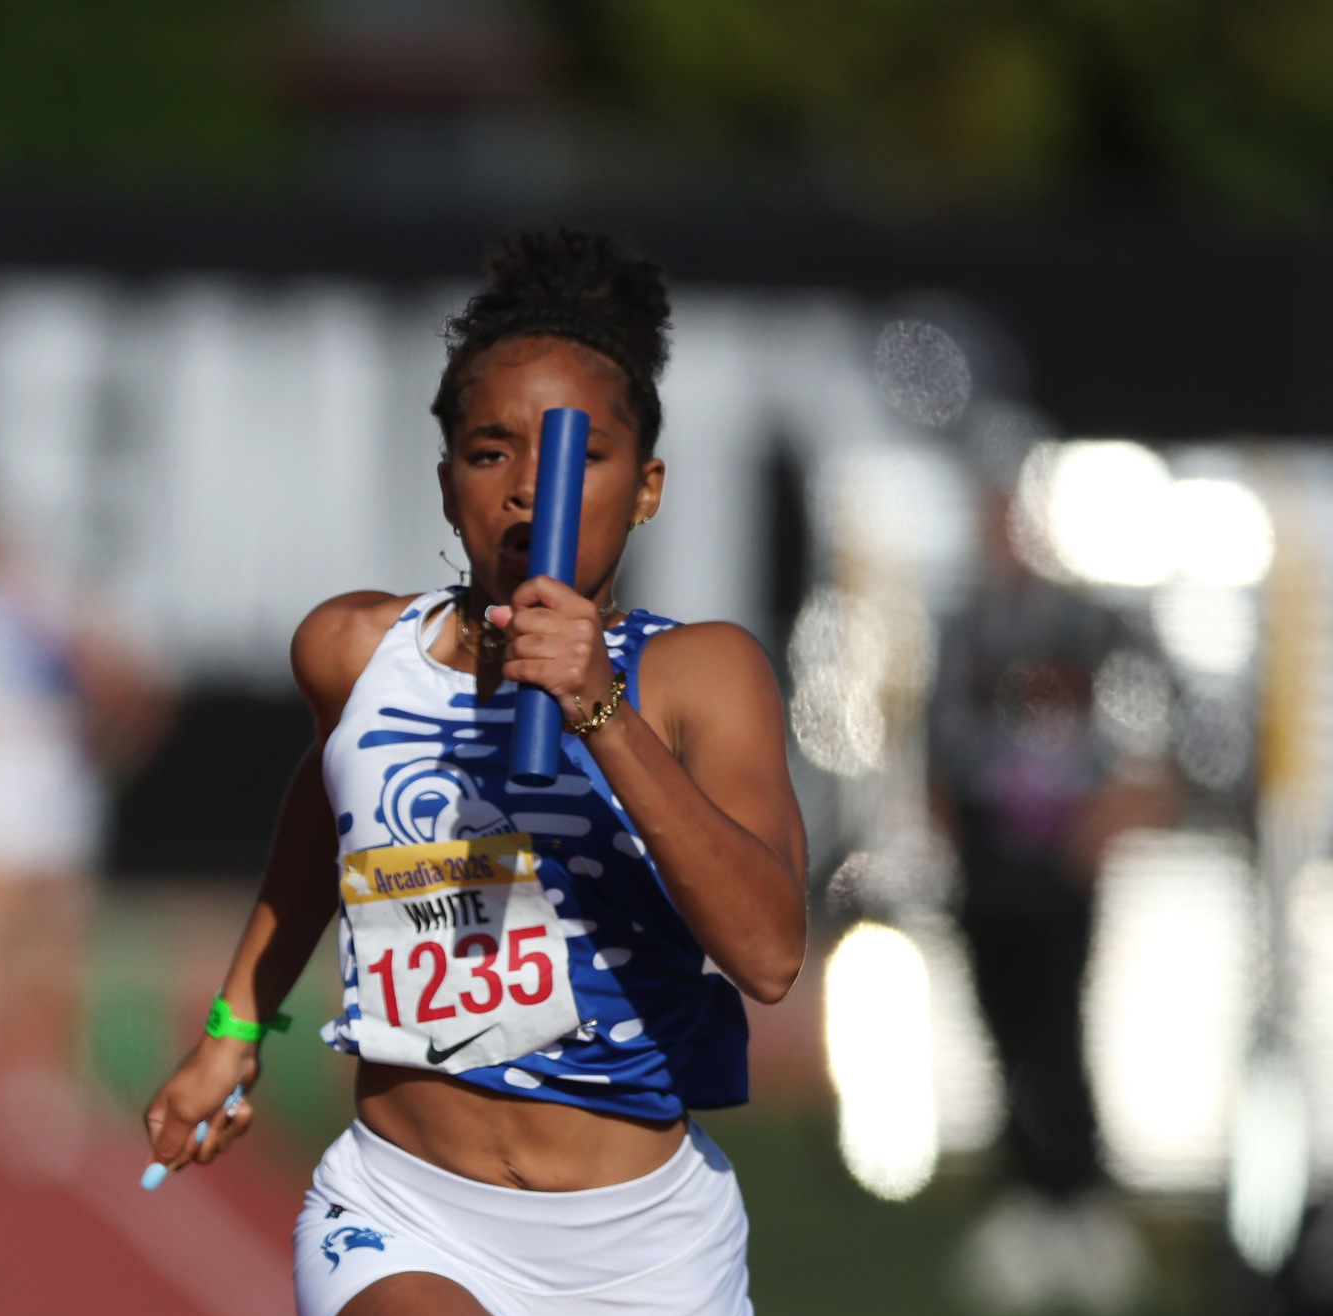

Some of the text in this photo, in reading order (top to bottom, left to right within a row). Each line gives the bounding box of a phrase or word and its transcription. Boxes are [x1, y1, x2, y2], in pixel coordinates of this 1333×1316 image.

[374, 854, 494, 894] Arcadia 2026
[403, 890, 491, 935] WHITE
[367, 924, 554, 1028] 1235
